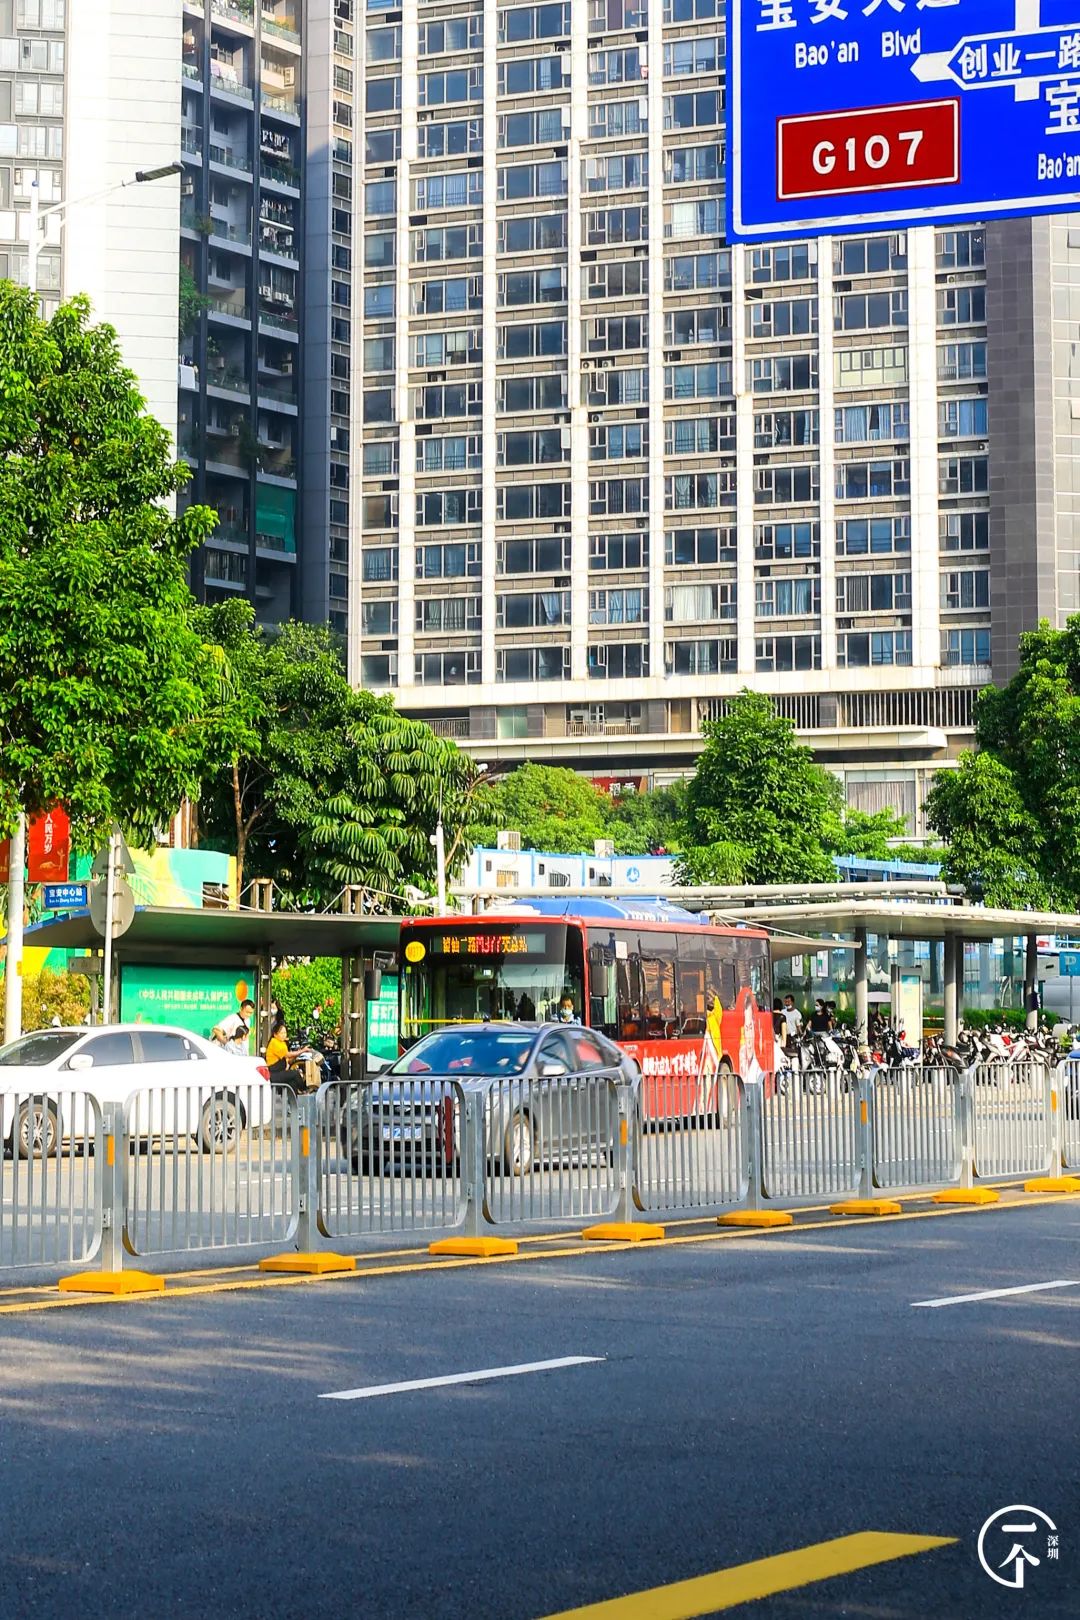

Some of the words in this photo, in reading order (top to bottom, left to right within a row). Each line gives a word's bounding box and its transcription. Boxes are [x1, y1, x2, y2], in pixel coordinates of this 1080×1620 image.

[795, 41, 859, 69] Bao'an
[881, 28, 921, 58] Blvd
[958, 33, 1080, 80] 创业一路
[812, 130, 924, 175] G107
